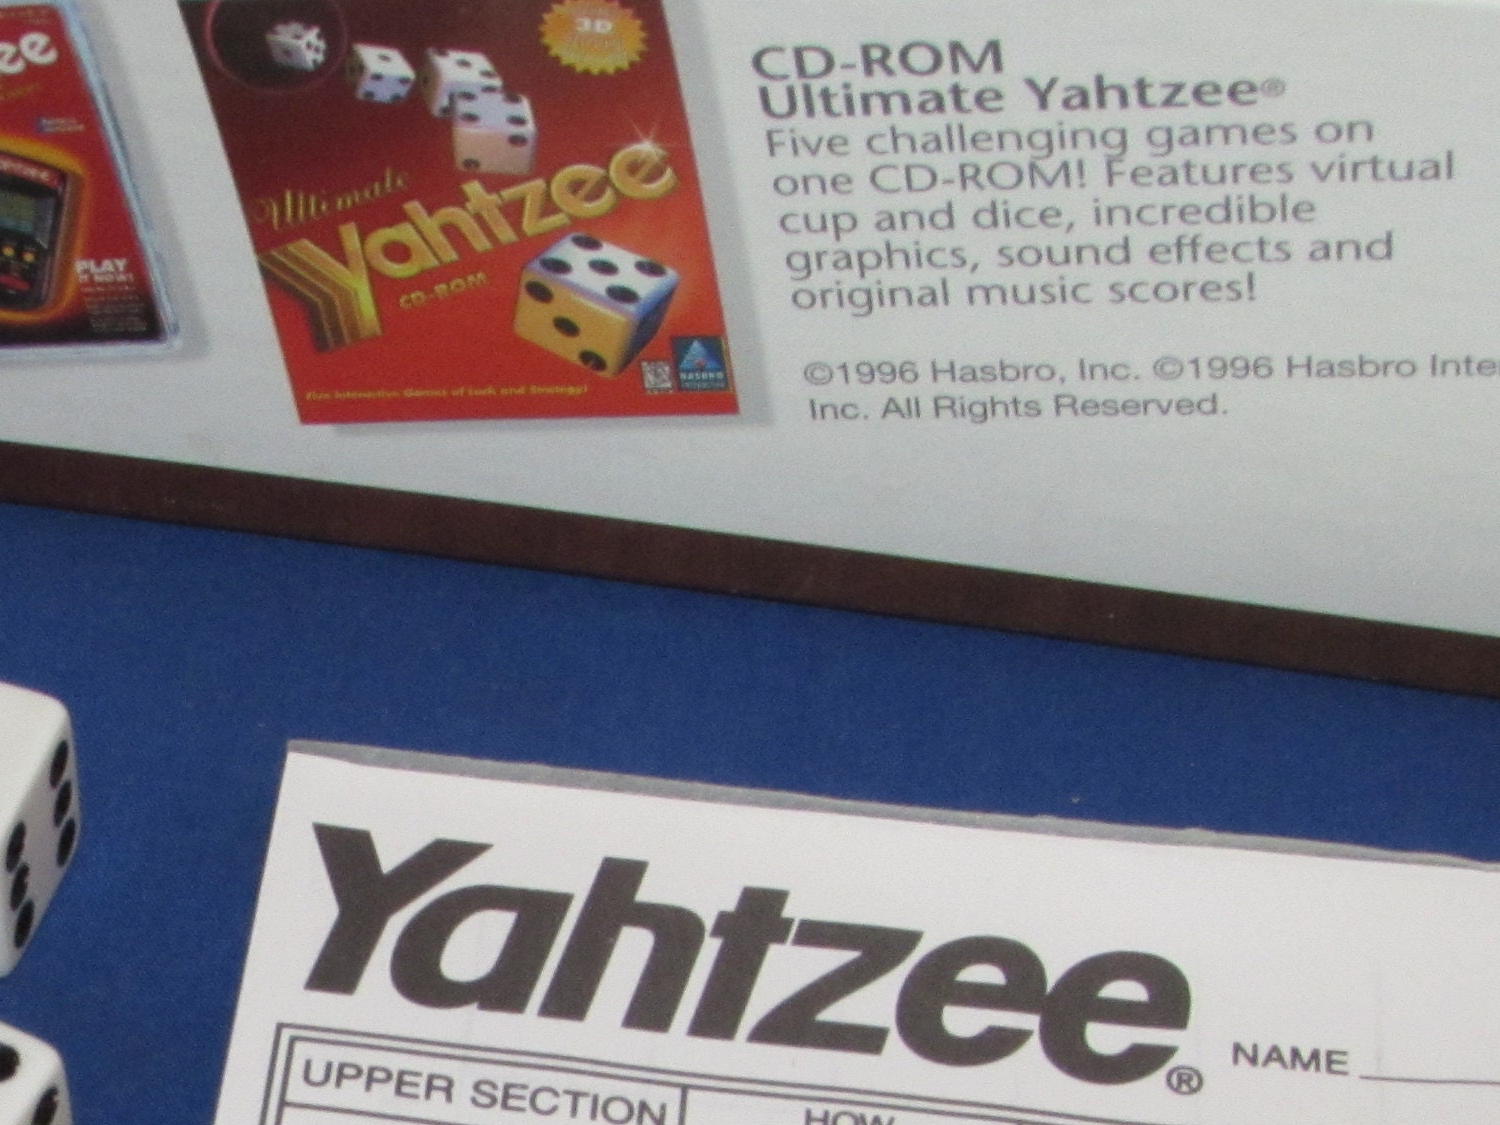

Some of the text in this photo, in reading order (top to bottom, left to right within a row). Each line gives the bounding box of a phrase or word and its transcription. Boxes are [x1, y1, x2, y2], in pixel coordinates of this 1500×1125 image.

[752, 40, 1003, 81] CD-ROM
[759, 83, 1003, 119] Ultimate
[766, 122, 1373, 159] Five challenging games on
[773, 151, 1452, 195] one CD-ROM! Features virtual
[780, 194, 1315, 241] cup and dice, incredible
[260, 140, 678, 352] Yahtzee
[786, 231, 1392, 280] graphics, sound effects and
[792, 272, 1254, 317] original music scores!
[931, 360, 1064, 383] Hasbro,
[1080, 359, 1141, 380] Inc.
[1287, 356, 1416, 377] Hasbro
[1431, 355, 1500, 376] Inte
[810, 393, 1229, 423] Inc. All Rights Reserved.
[1232, 1042, 1349, 1076] NAME
[303, 1059, 454, 1103] UPPER
